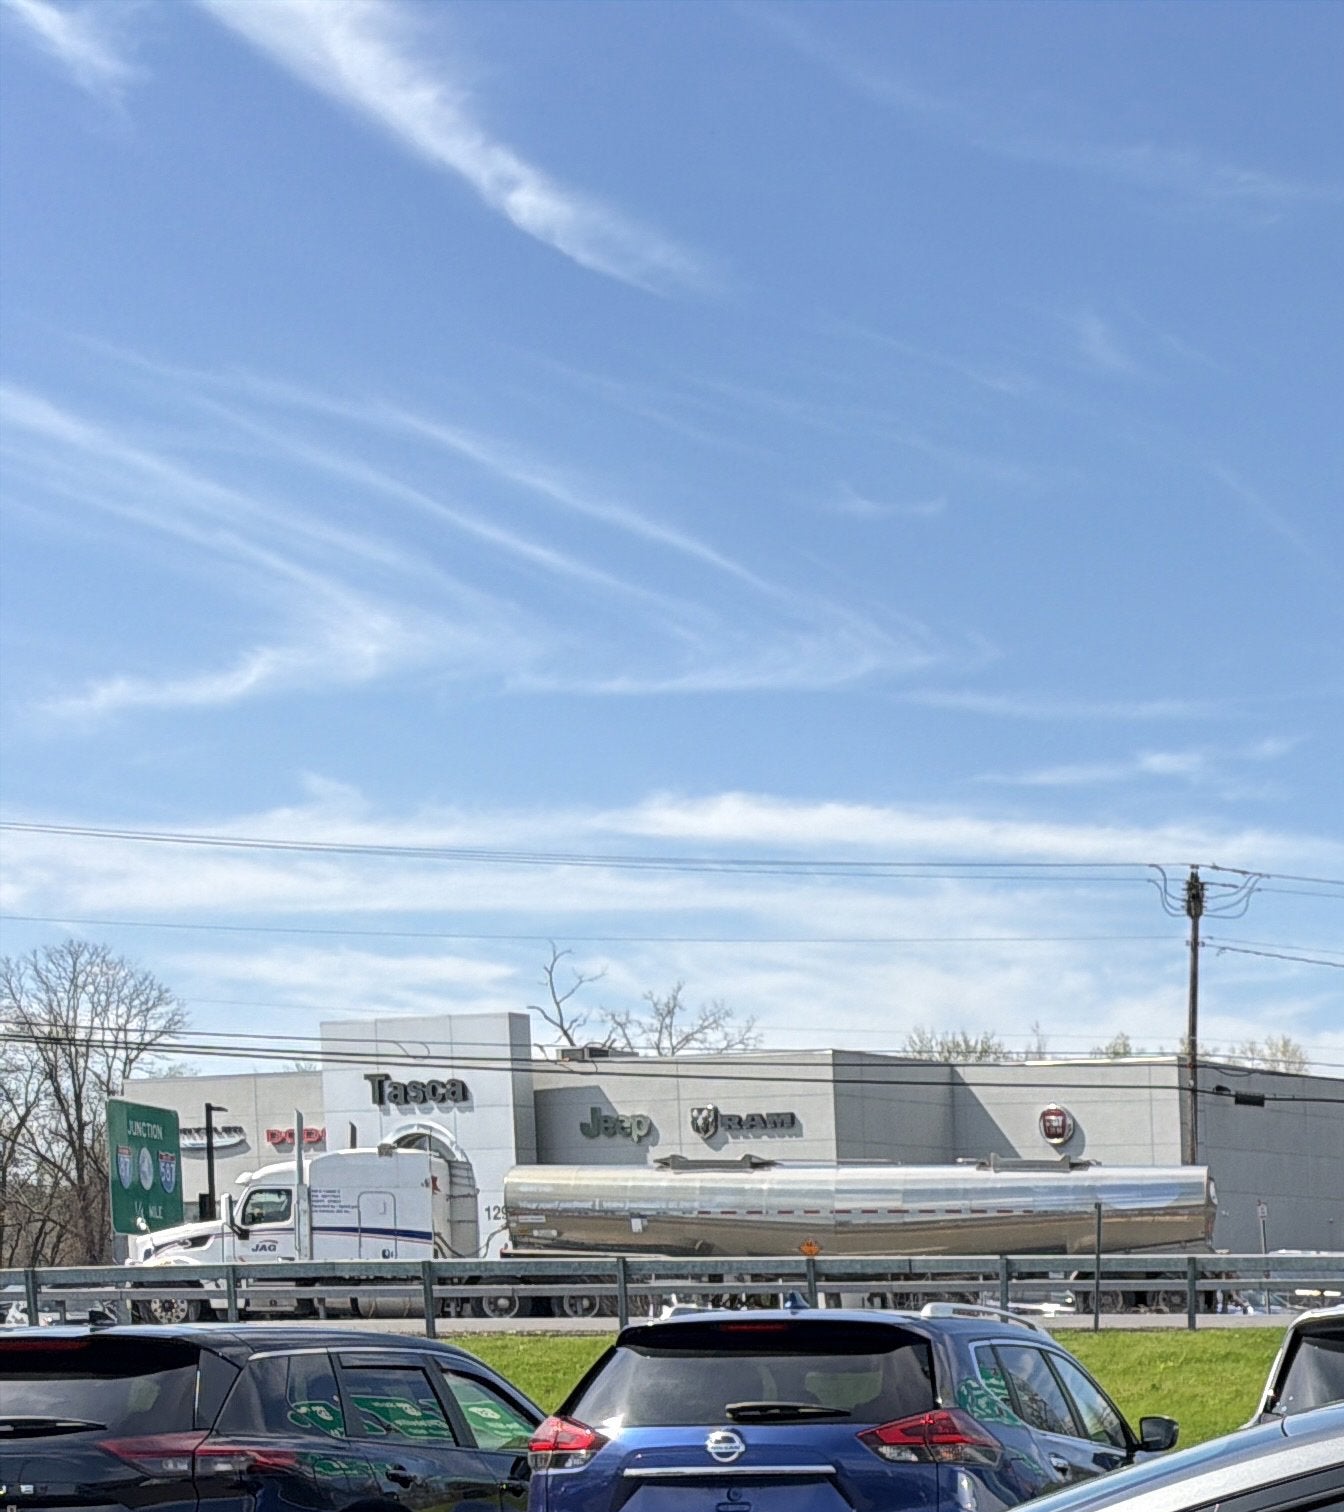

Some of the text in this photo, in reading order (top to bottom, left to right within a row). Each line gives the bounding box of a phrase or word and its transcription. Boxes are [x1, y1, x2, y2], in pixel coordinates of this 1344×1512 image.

[364, 1073, 467, 1106] Tasca
[127, 1119, 164, 1140] JUNCTION
[579, 1106, 651, 1144] Jeep
[720, 1112, 796, 1131] RAM
[160, 1160, 176, 1182] 587
[251, 1243, 277, 1253] JAG
